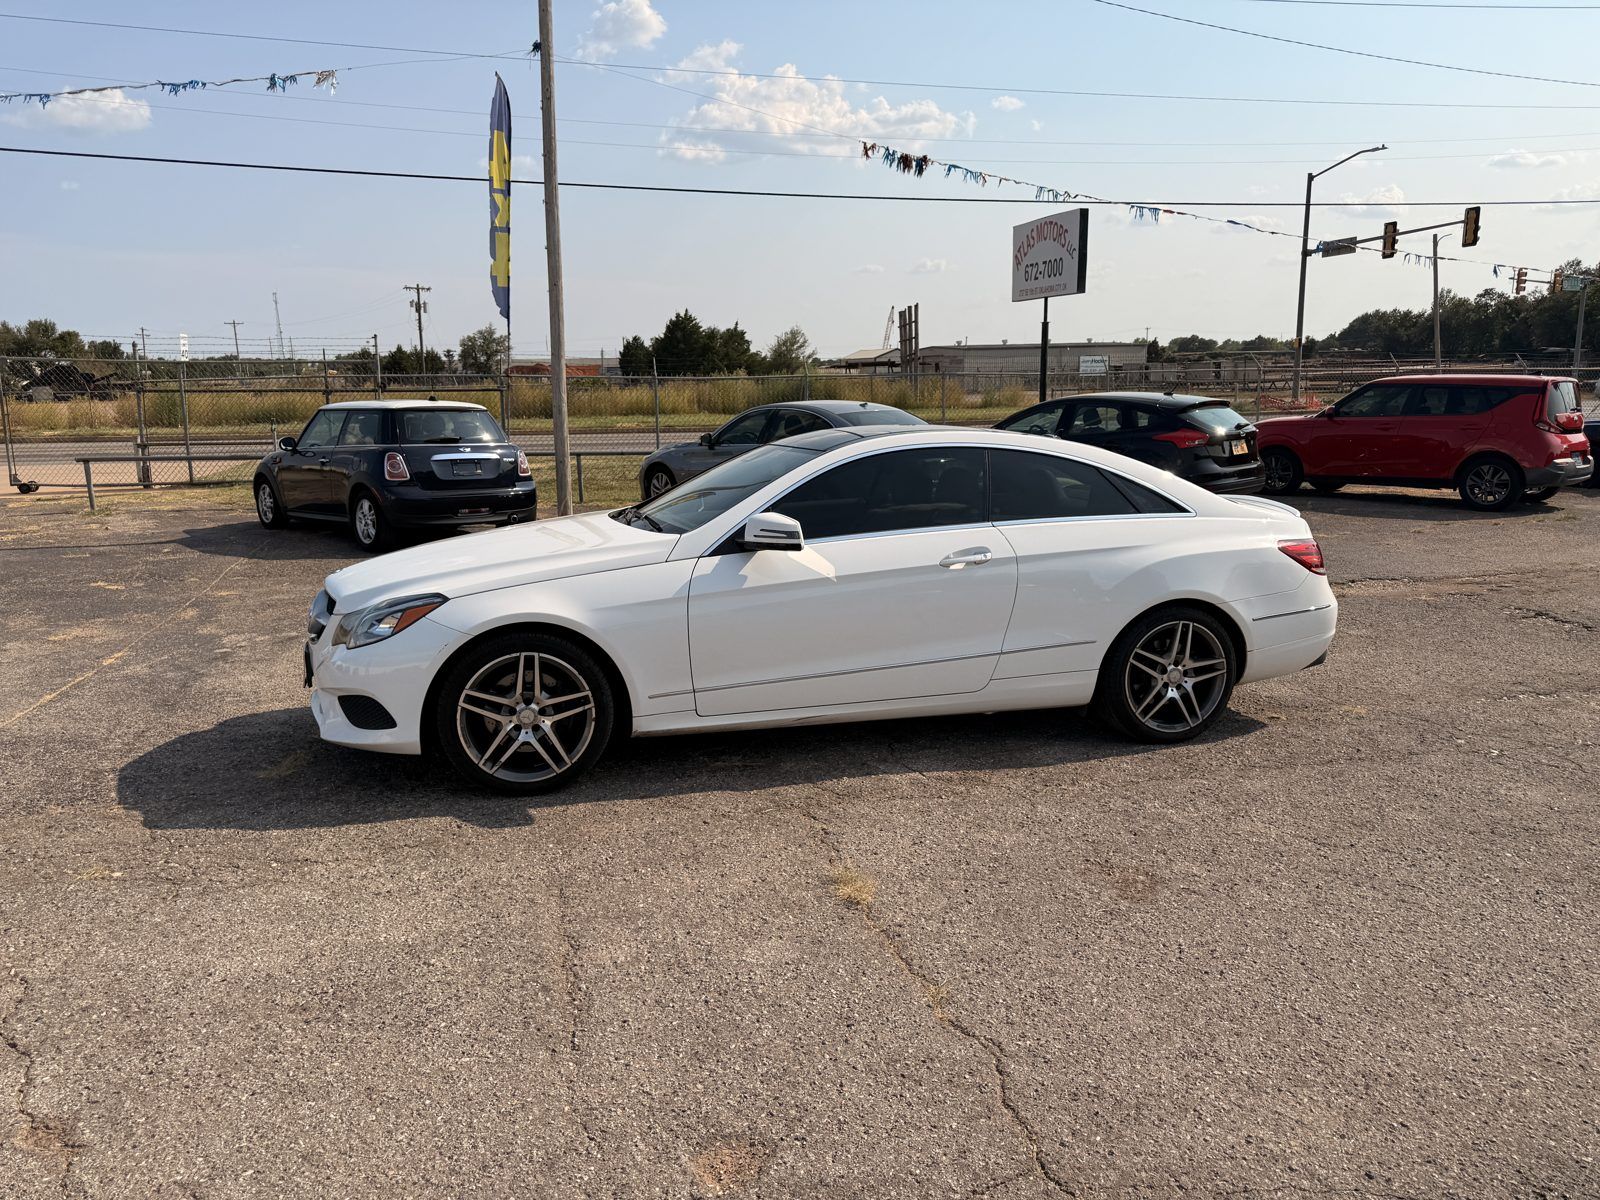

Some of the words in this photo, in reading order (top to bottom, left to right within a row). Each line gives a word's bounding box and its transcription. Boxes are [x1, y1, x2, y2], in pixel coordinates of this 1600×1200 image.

[1014, 228, 1035, 272] ATLAS
[1035, 220, 1069, 249] MOTORS
[1066, 239, 1077, 260] LLC
[1024, 257, 1063, 282] 672-7000
